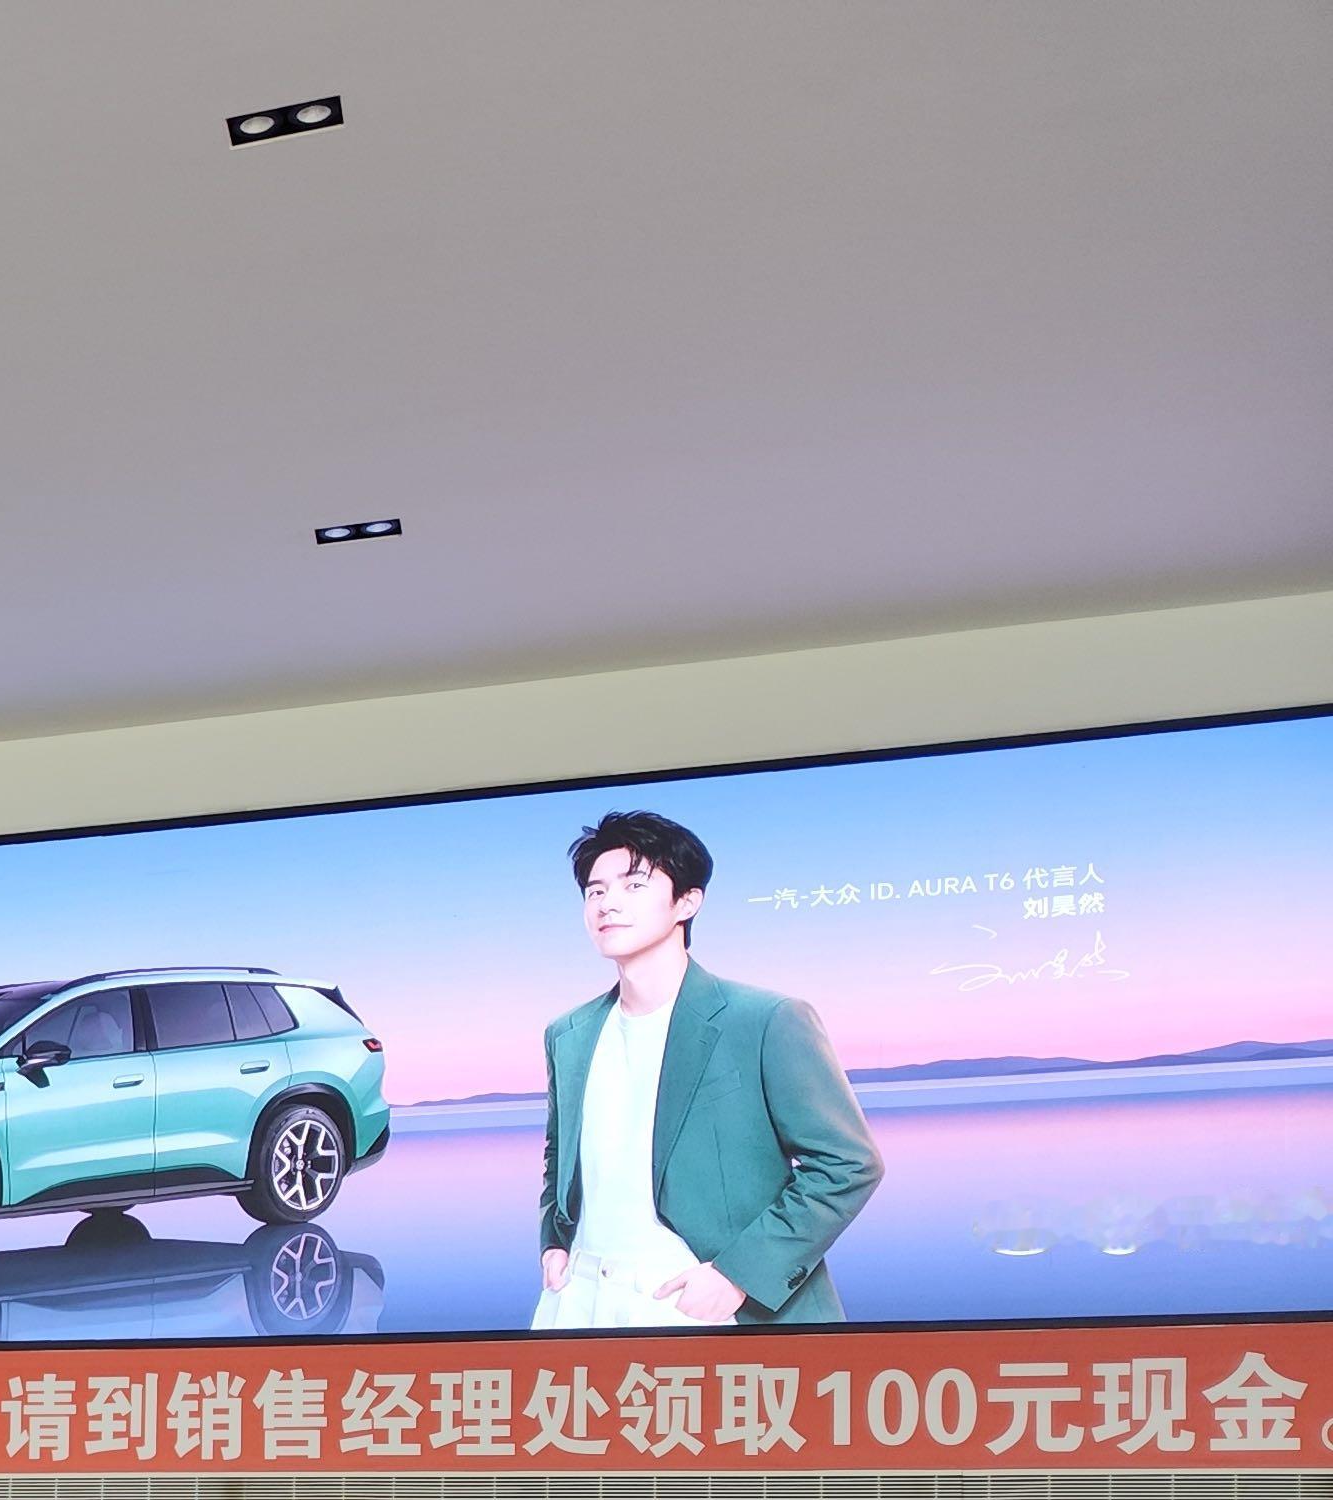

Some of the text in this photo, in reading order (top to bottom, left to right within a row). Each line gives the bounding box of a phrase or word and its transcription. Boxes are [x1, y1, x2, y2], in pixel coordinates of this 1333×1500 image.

[870, 881, 901, 905] ID.
[907, 875, 979, 899] AURA
[983, 873, 1017, 895] T6
[1022, 862, 1106, 891] 代言人
[1022, 892, 1106, 920] 刘昊然
